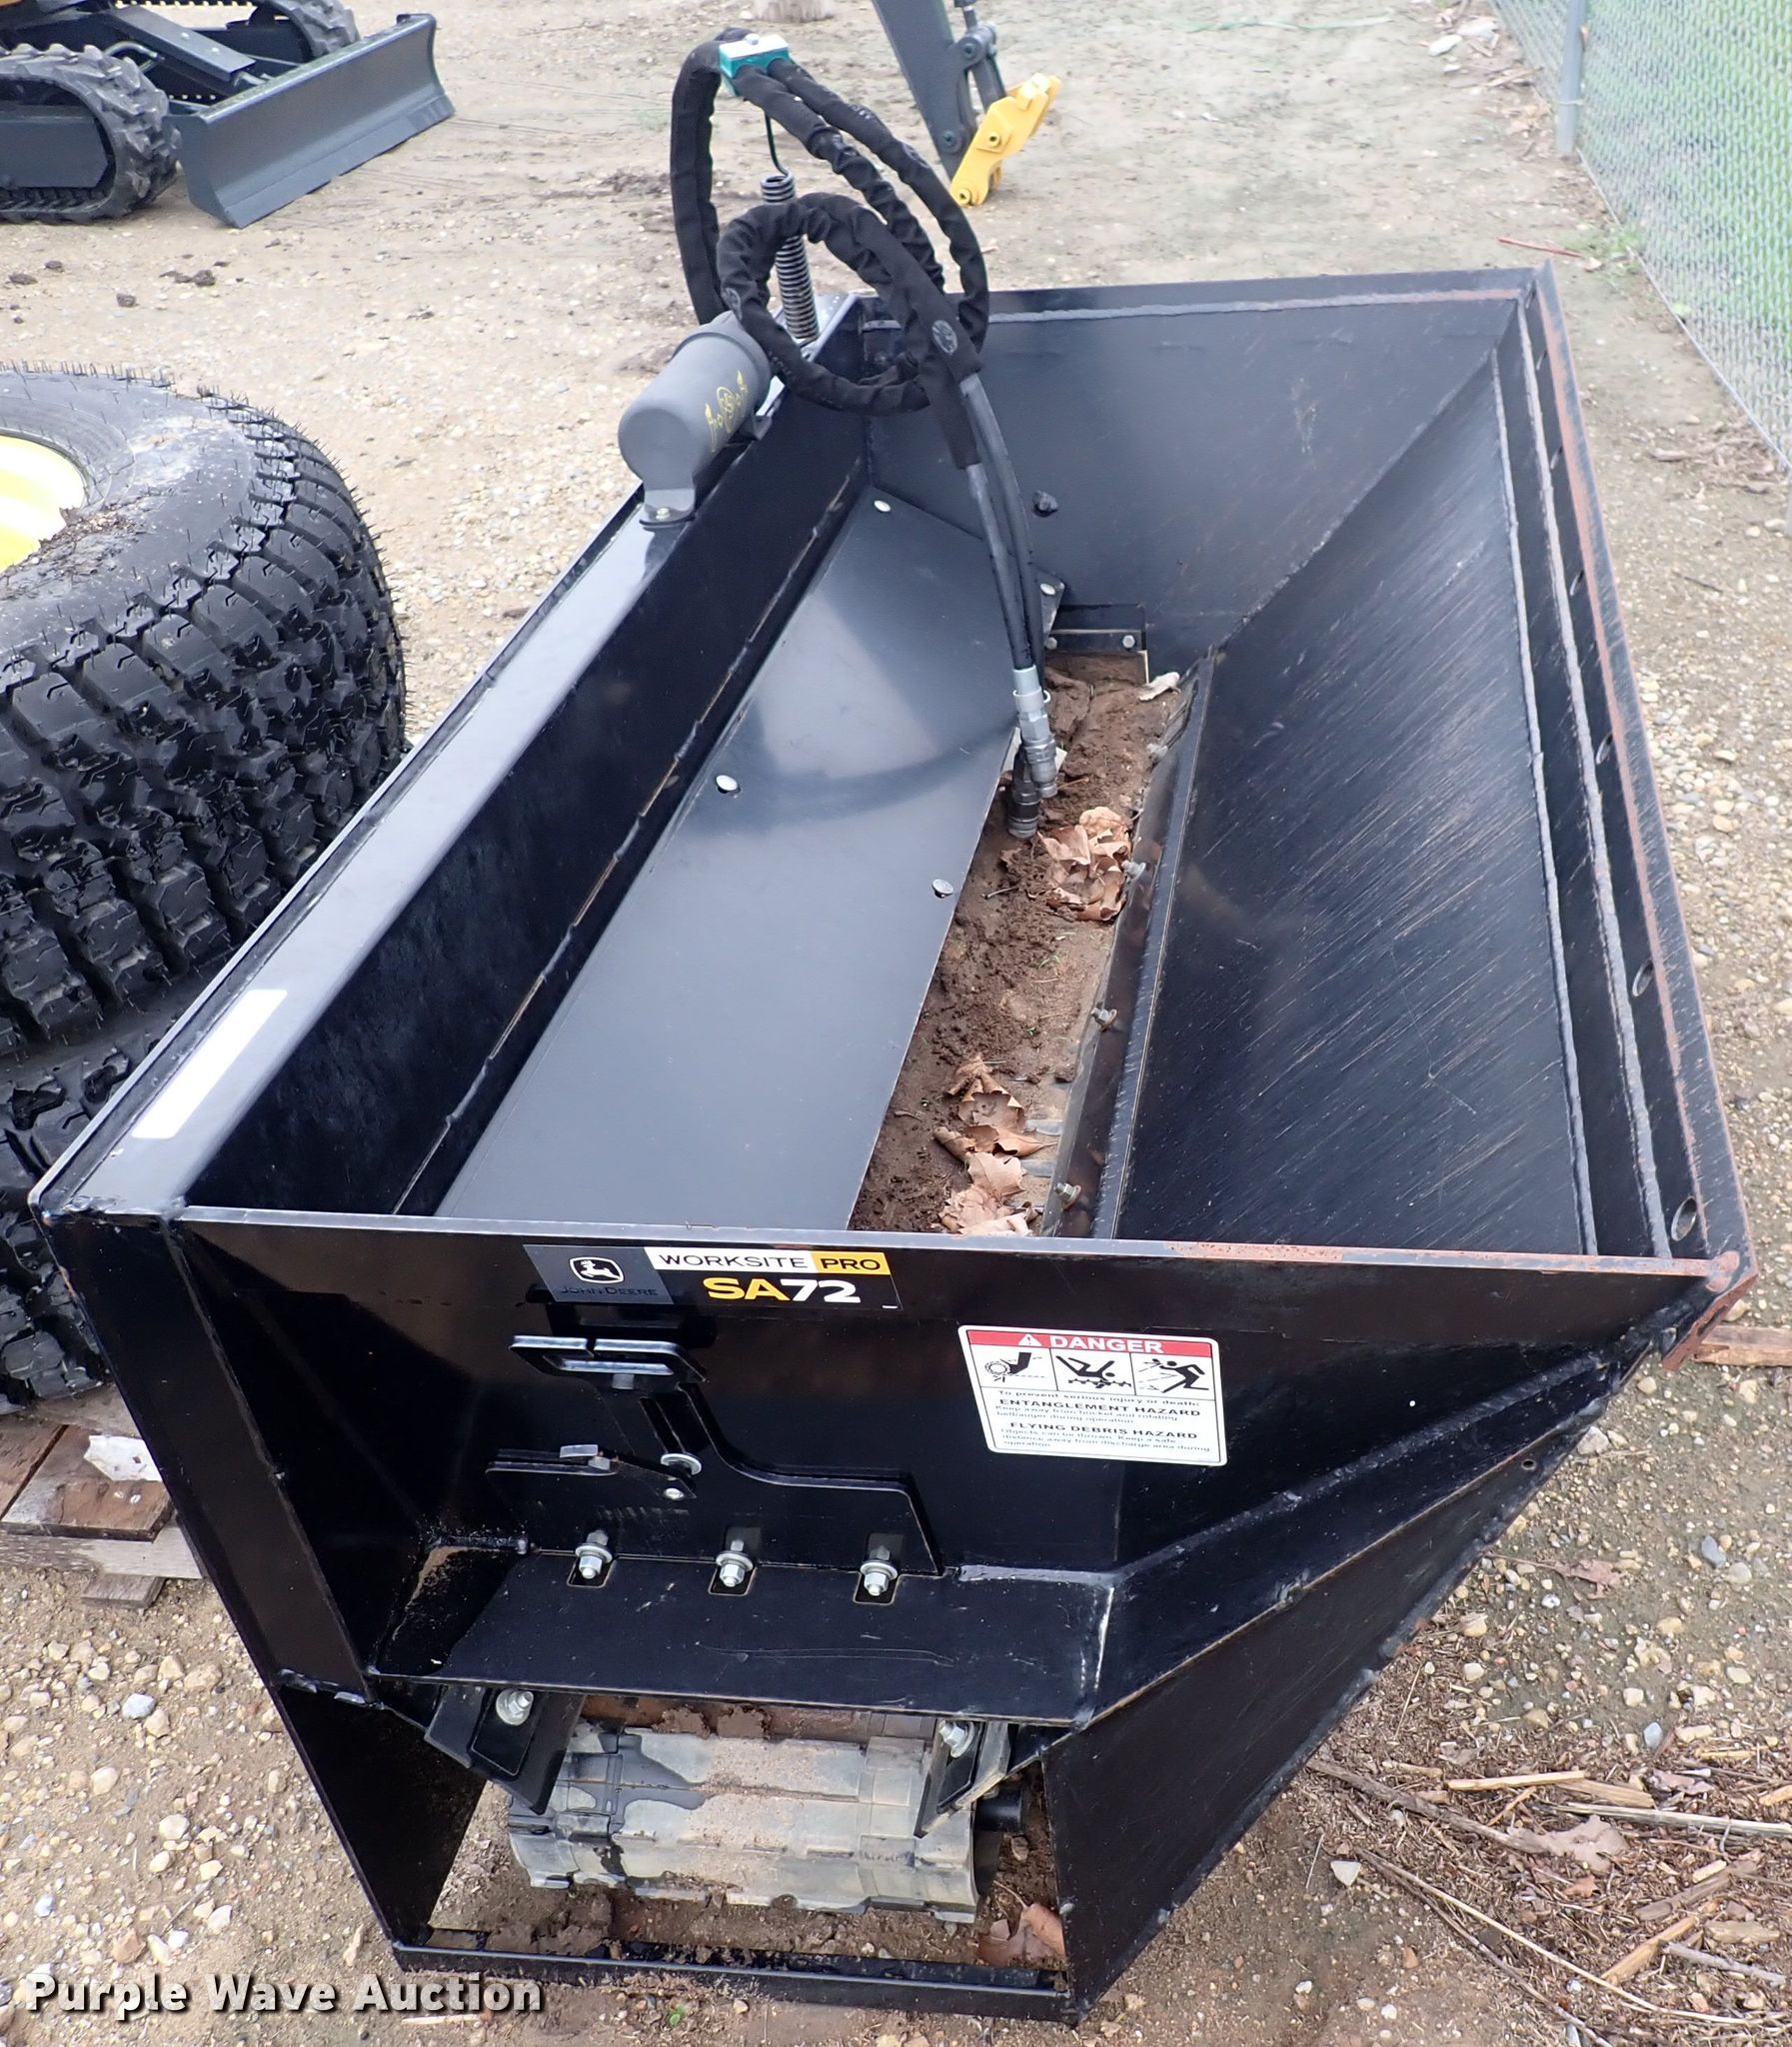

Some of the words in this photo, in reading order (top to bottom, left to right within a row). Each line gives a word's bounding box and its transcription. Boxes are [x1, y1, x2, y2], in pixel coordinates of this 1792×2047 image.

[660, 1253, 809, 1268] WORKSITE
[822, 1258, 882, 1270] PRO
[561, 1284, 603, 1295] JOHN
[605, 1286, 658, 1297] DEERE
[703, 1277, 862, 1303] SA72
[1049, 1335, 1164, 1353] DANGER
[999, 1399, 1128, 1411] ENTANGLEMENT
[1070, 1425, 1127, 1434] DEBRIS
[1133, 1429, 1197, 1438] HAZARD
